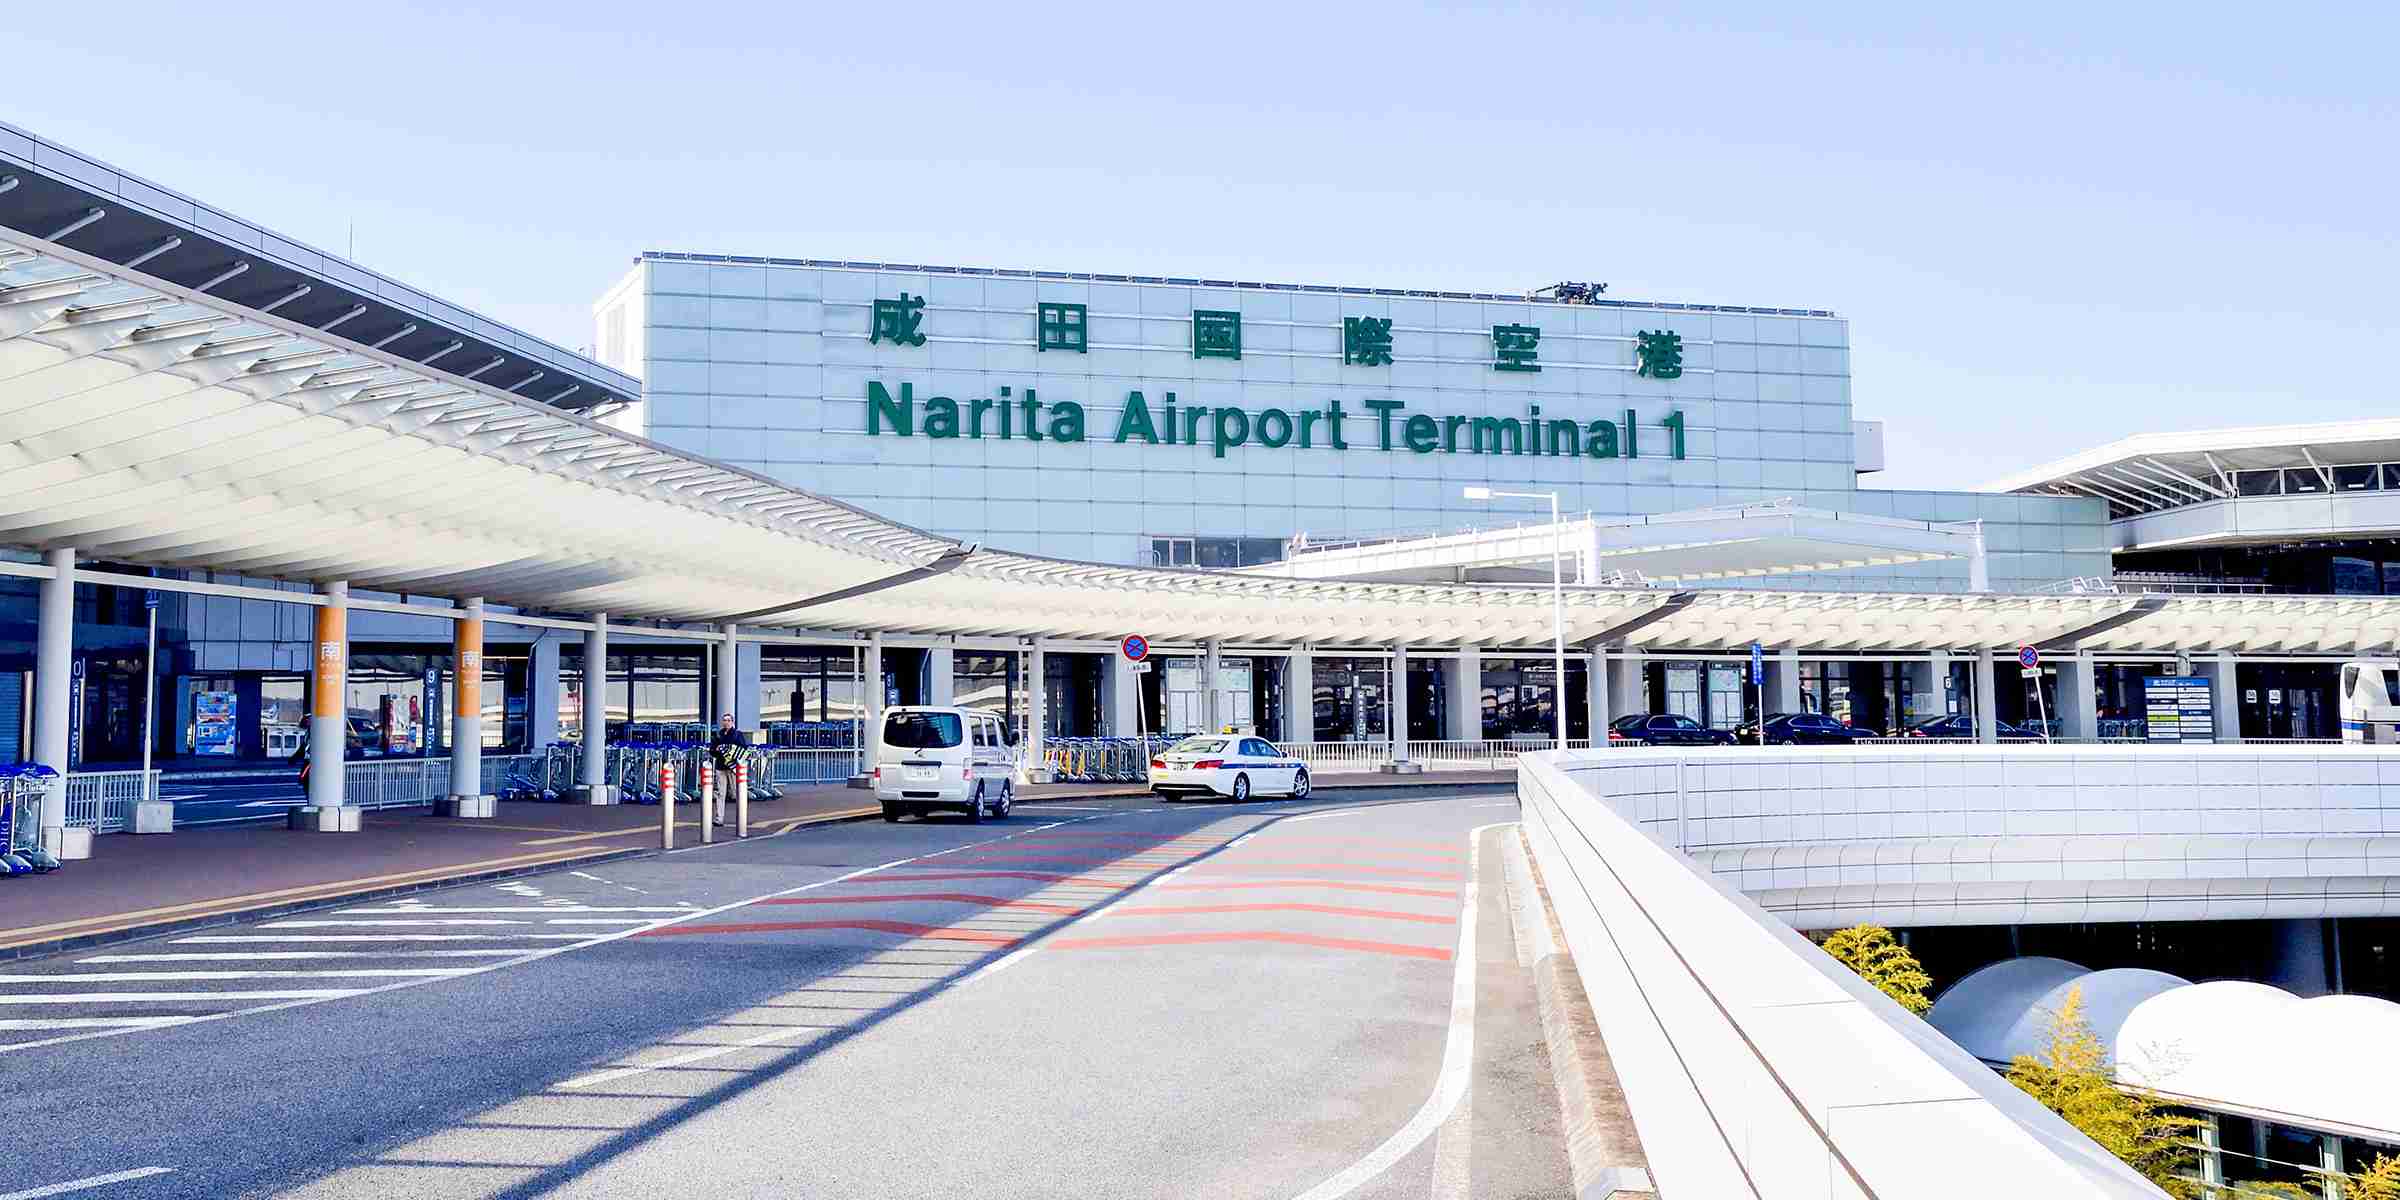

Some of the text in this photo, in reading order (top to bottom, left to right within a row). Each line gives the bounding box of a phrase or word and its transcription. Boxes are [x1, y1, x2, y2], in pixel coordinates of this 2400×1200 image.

[868, 293, 1683, 379] 成田国際空港
[867, 380, 1686, 461] Narita Airport Terminal 1
[320, 641, 342, 662] 南
[427, 670, 436, 684] 9
